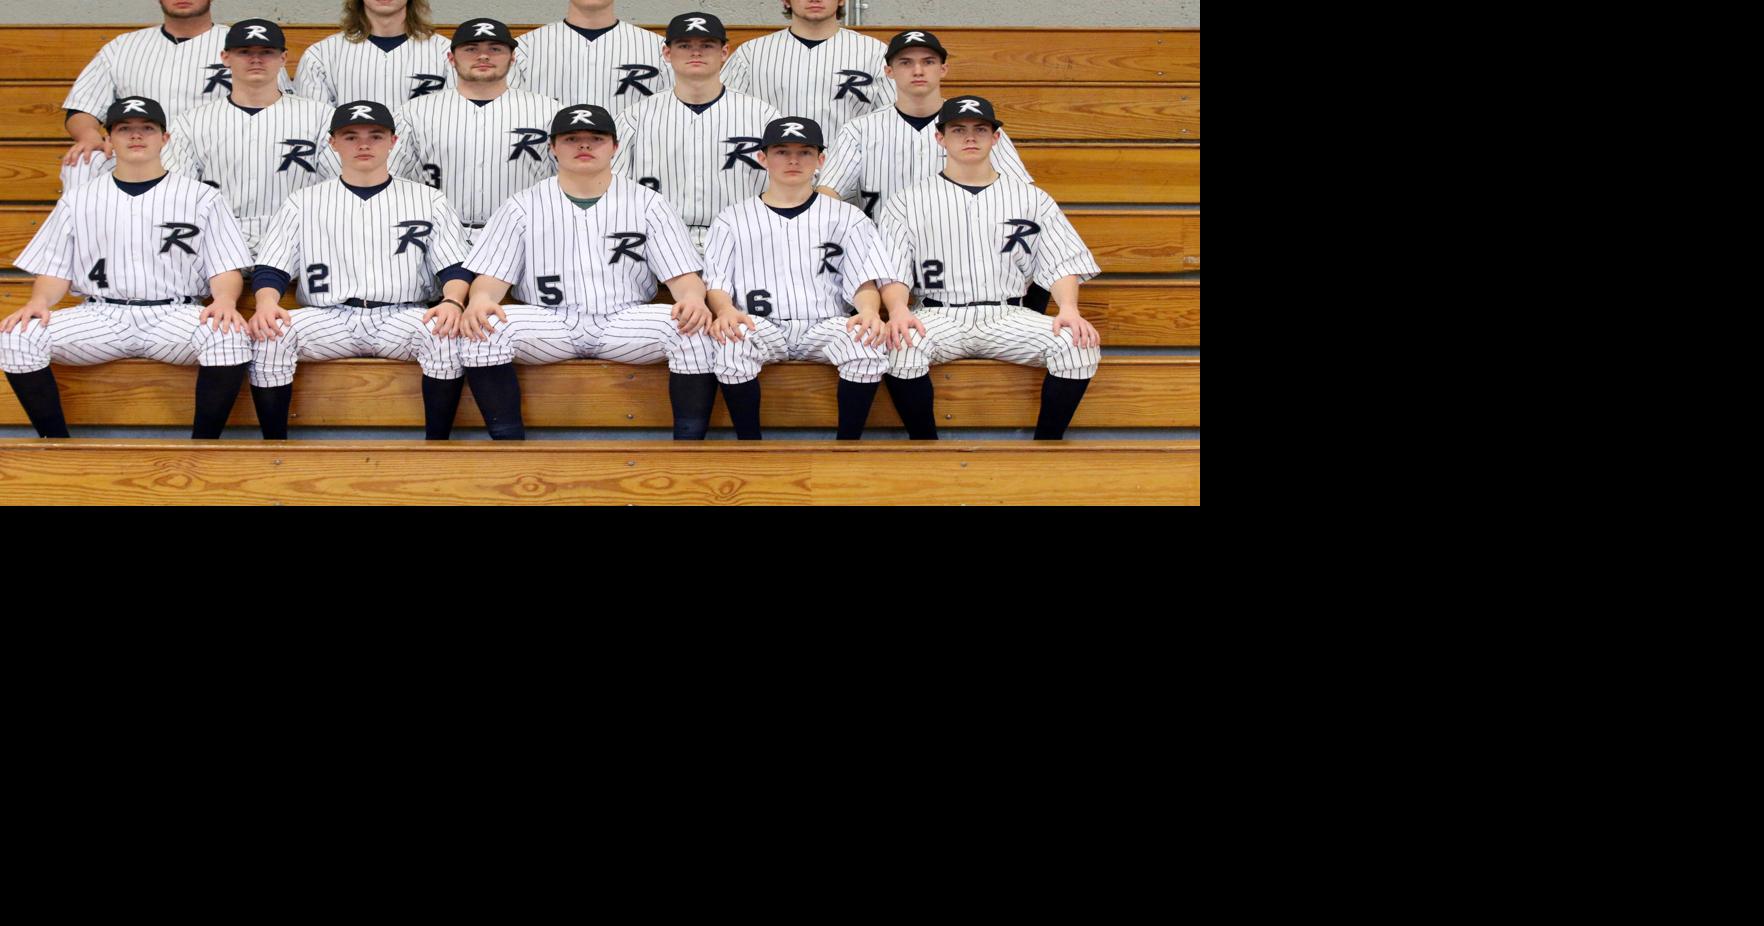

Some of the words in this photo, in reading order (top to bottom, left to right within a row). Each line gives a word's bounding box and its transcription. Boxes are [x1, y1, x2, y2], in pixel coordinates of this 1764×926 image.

[244, 25, 270, 41] R
[472, 22, 497, 37] R
[683, 17, 709, 32] R
[904, 31, 926, 46] R
[613, 64, 659, 96] R
[833, 69, 873, 103] R
[121, 99, 148, 114] R
[349, 105, 375, 121] R
[569, 109, 596, 125] R
[957, 99, 983, 115] R
[506, 127, 548, 162] R
[780, 122, 806, 138] R
[276, 139, 317, 173] R
[720, 137, 767, 170] R
[423, 164, 441, 190] 3
[861, 191, 879, 217] 7
[155, 222, 200, 255] R
[392, 220, 433, 255] R
[606, 232, 647, 265] R
[1000, 219, 1041, 255] R
[88, 257, 109, 289] 4
[816, 243, 843, 274] R
[306, 263, 329, 293] 2
[536, 275, 563, 305] 5
[746, 289, 771, 317] 6
